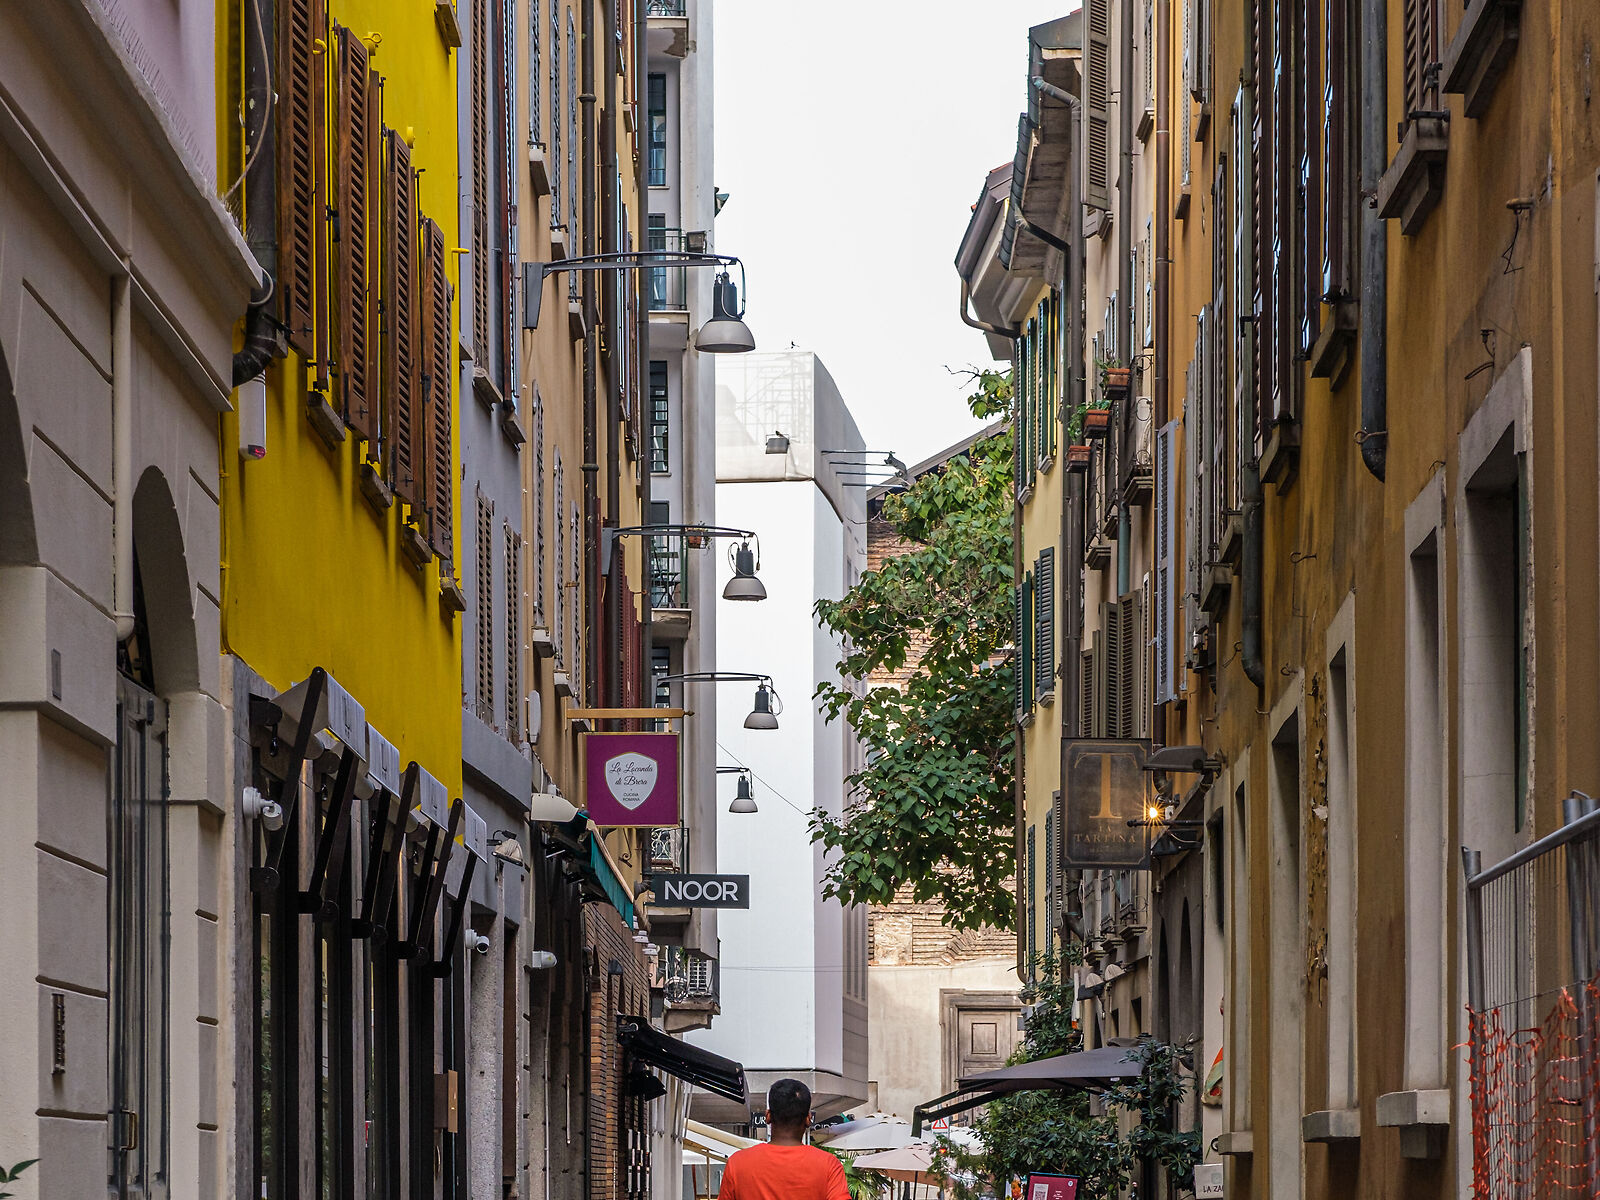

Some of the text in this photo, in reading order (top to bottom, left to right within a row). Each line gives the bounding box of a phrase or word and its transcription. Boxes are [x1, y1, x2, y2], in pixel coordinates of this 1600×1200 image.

[610, 762, 653, 775] La Locanda
[615, 776, 648, 786] di Brera
[1074, 834, 1136, 843] TARTINA
[664, 881, 738, 901] NOOR
[1203, 1185, 1212, 1193] LA
